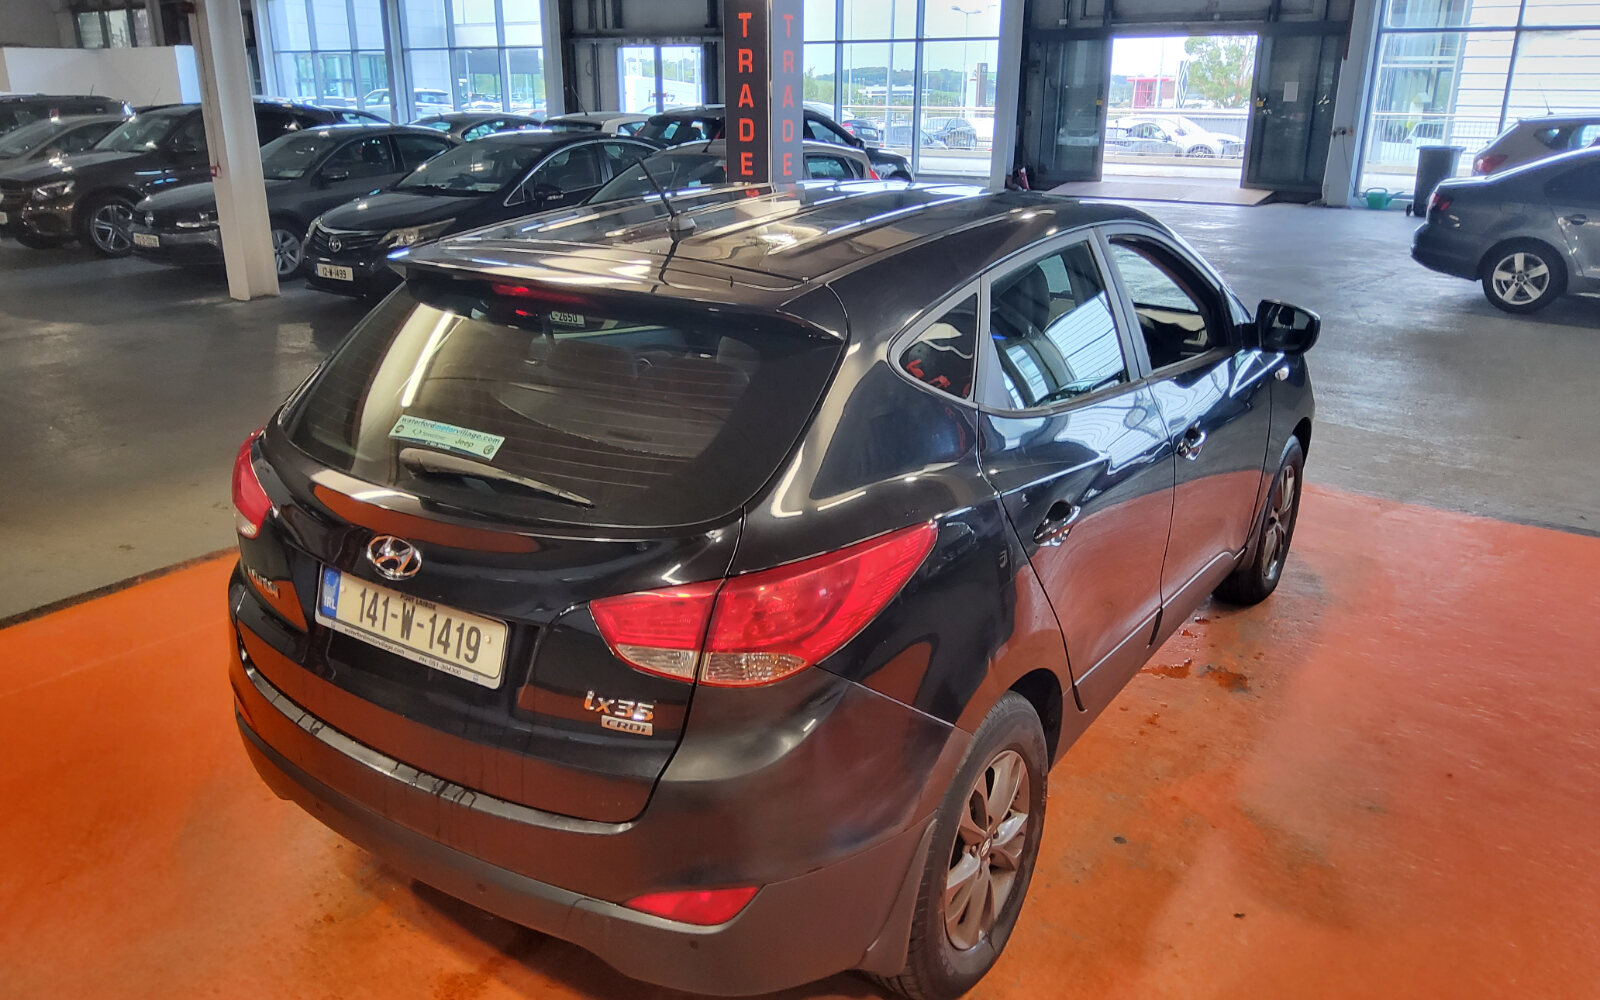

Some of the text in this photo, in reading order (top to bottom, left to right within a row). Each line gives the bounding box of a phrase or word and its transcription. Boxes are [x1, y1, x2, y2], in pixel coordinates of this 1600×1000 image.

[738, 12, 754, 176] TRADE
[782, 14, 794, 176] TRADE
[401, 416, 501, 444] waterfordmotorvillage.com
[455, 438, 475, 448] Jeep
[323, 596, 336, 610] IRL
[359, 587, 481, 664] 141-W-1419
[584, 690, 654, 721] ix35
[606, 719, 647, 732] CRDi
